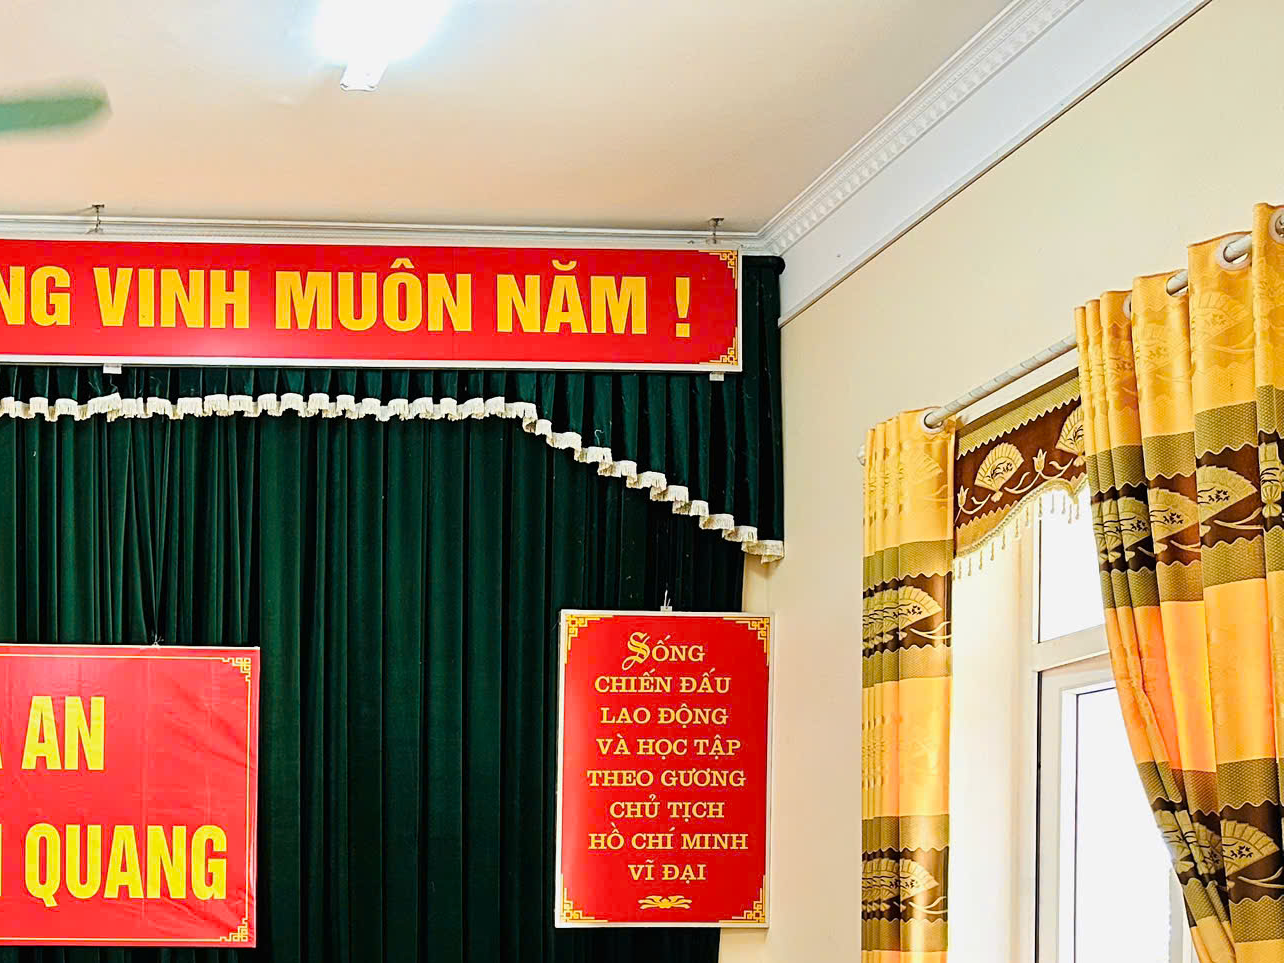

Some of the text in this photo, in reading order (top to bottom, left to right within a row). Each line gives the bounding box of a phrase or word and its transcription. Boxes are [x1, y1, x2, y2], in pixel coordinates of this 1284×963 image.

[93, 267, 250, 329] VINH
[275, 257, 472, 333] MUÔN
[496, 259, 647, 335] NĂM
[621, 630, 706, 672] SỐNG
[594, 667, 732, 695] CHIẾN ĐẤU
[600, 703, 728, 729] LAO ĐỘNG
[21, 695, 105, 771] AN
[595, 735, 741, 761] VÀ HỌC TẬP
[586, 767, 746, 787] THEO GƯƠNG
[609, 794, 725, 823] CHỦ TỊCH
[588, 822, 749, 851] HỒ CHÍ MINH
[24, 822, 228, 908] QUANG
[628, 858, 707, 885] VĨ ĐẠI
